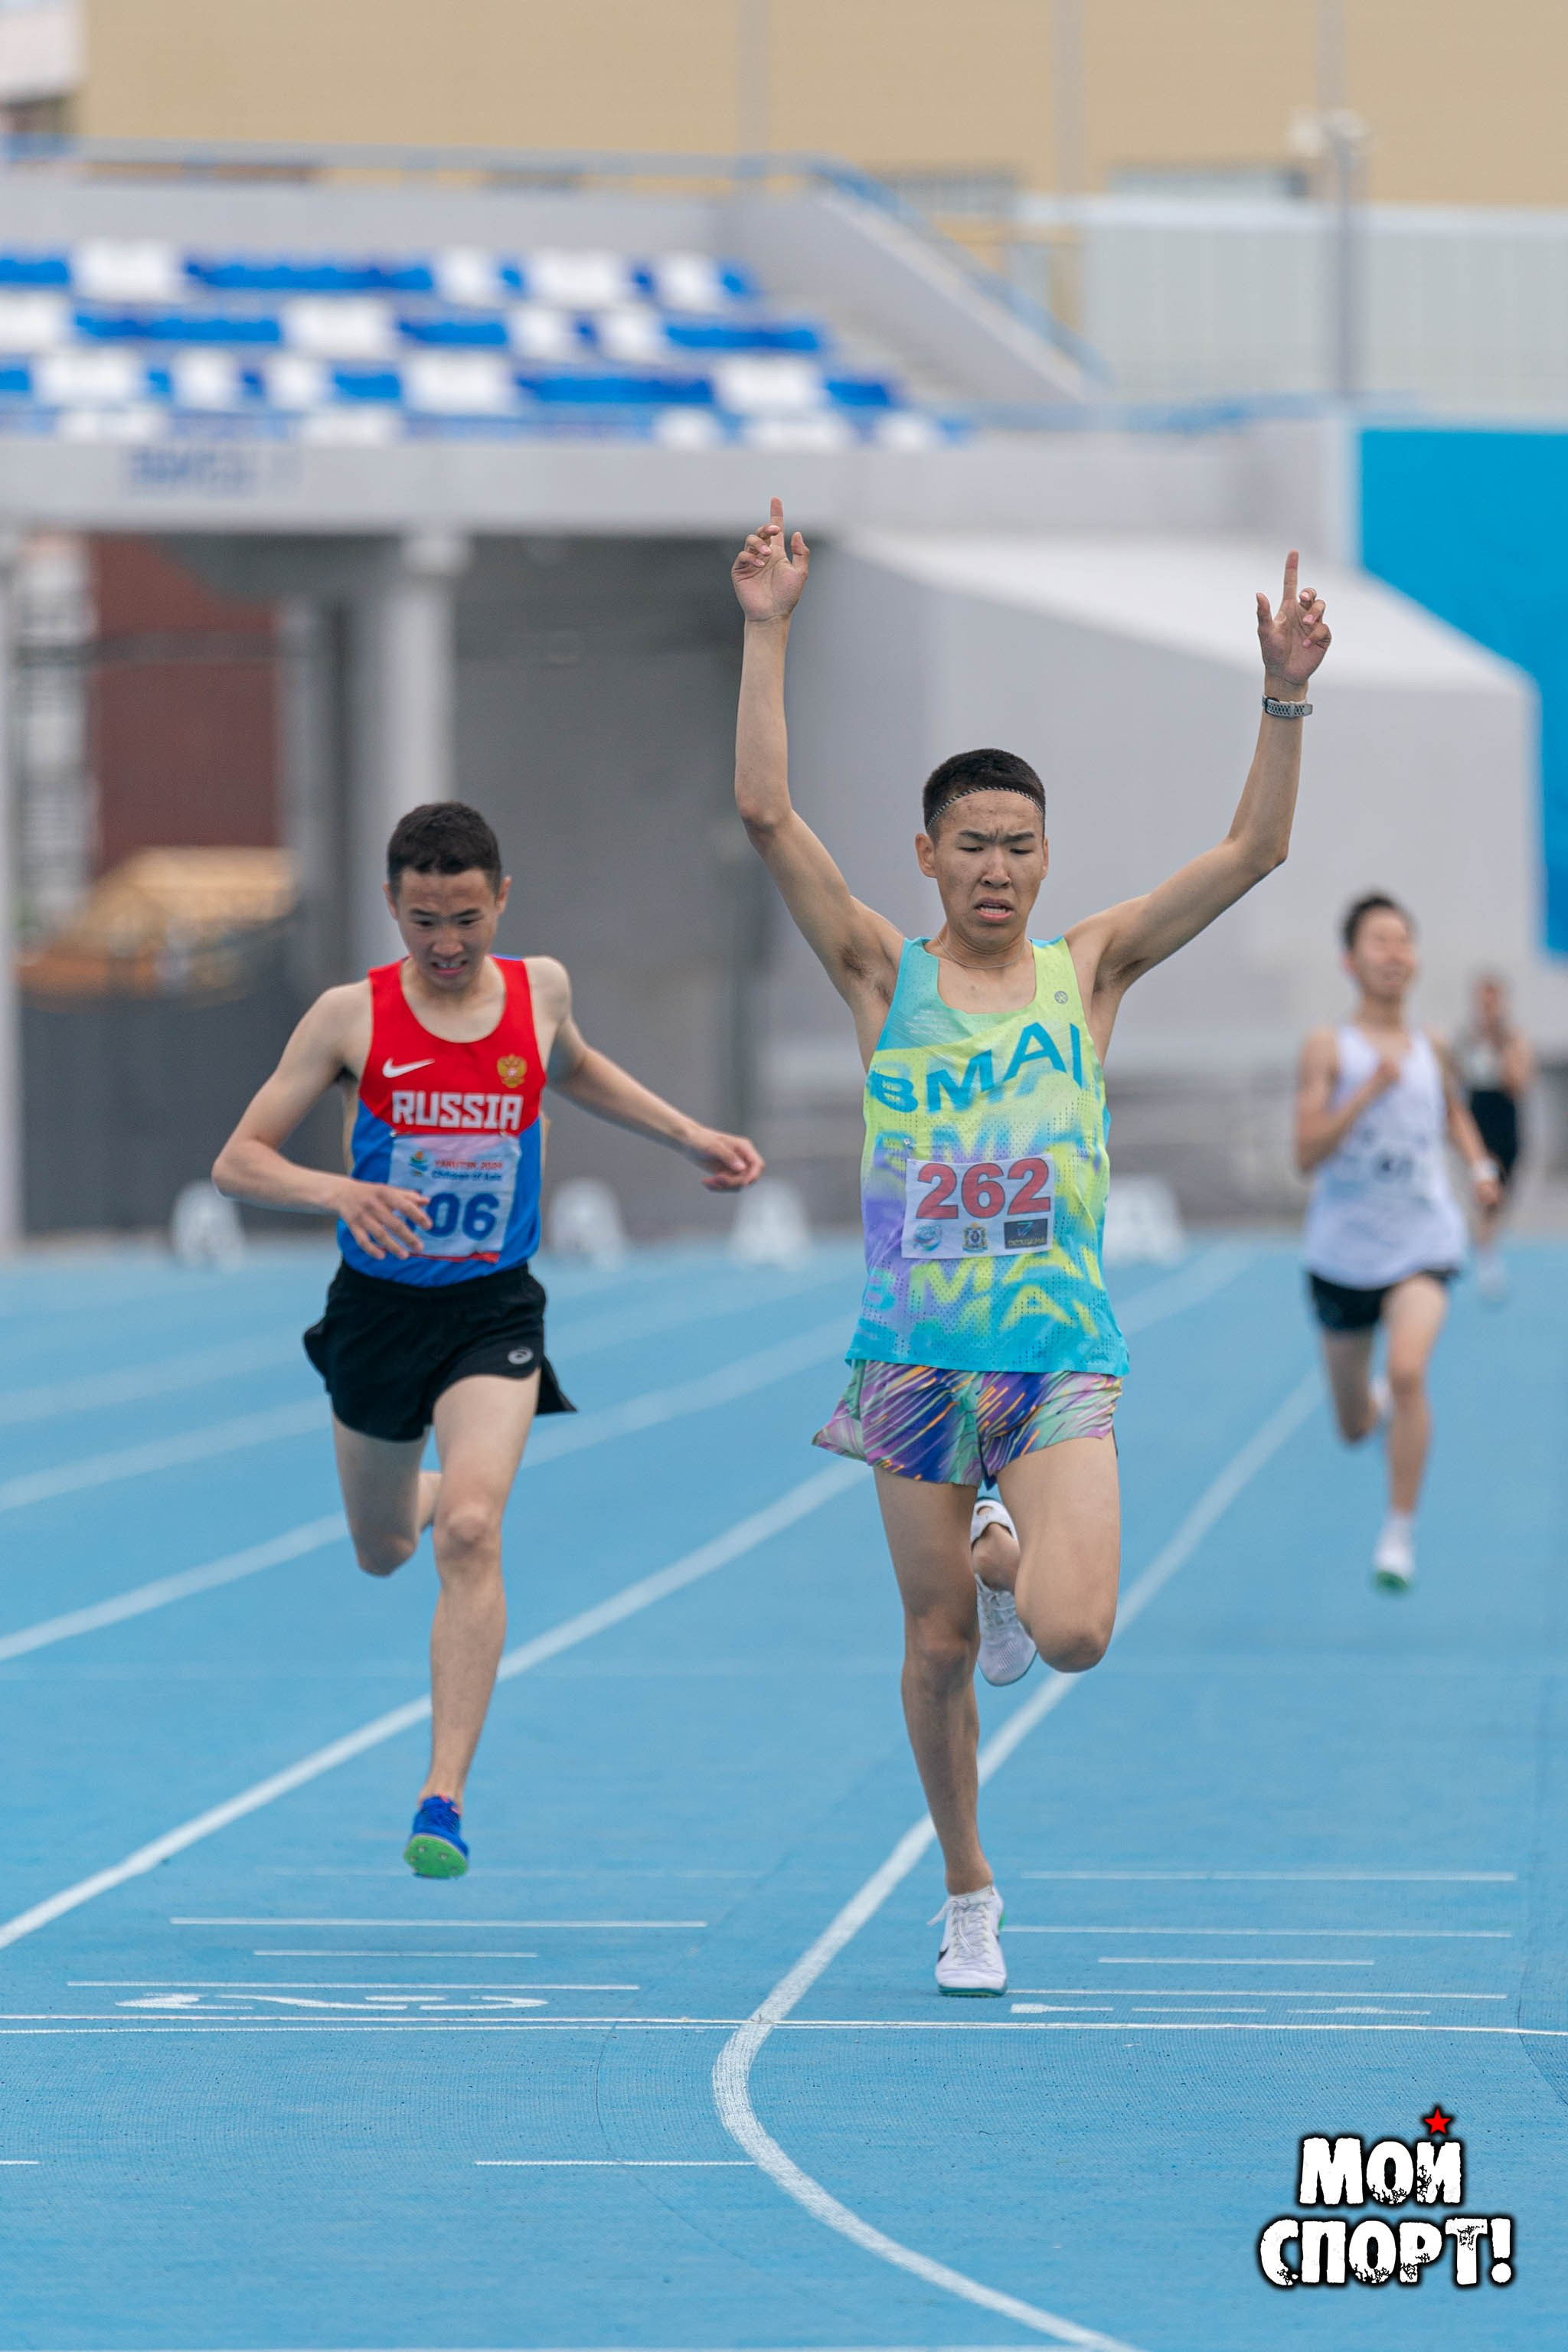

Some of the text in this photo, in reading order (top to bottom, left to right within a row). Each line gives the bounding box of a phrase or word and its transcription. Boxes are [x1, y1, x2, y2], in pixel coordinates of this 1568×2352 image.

[870, 1021, 1083, 1114] BMAI
[392, 1089, 524, 1130] RUSSIA
[406, 1192, 500, 1240] 06
[916, 1158, 1051, 1220] 262
